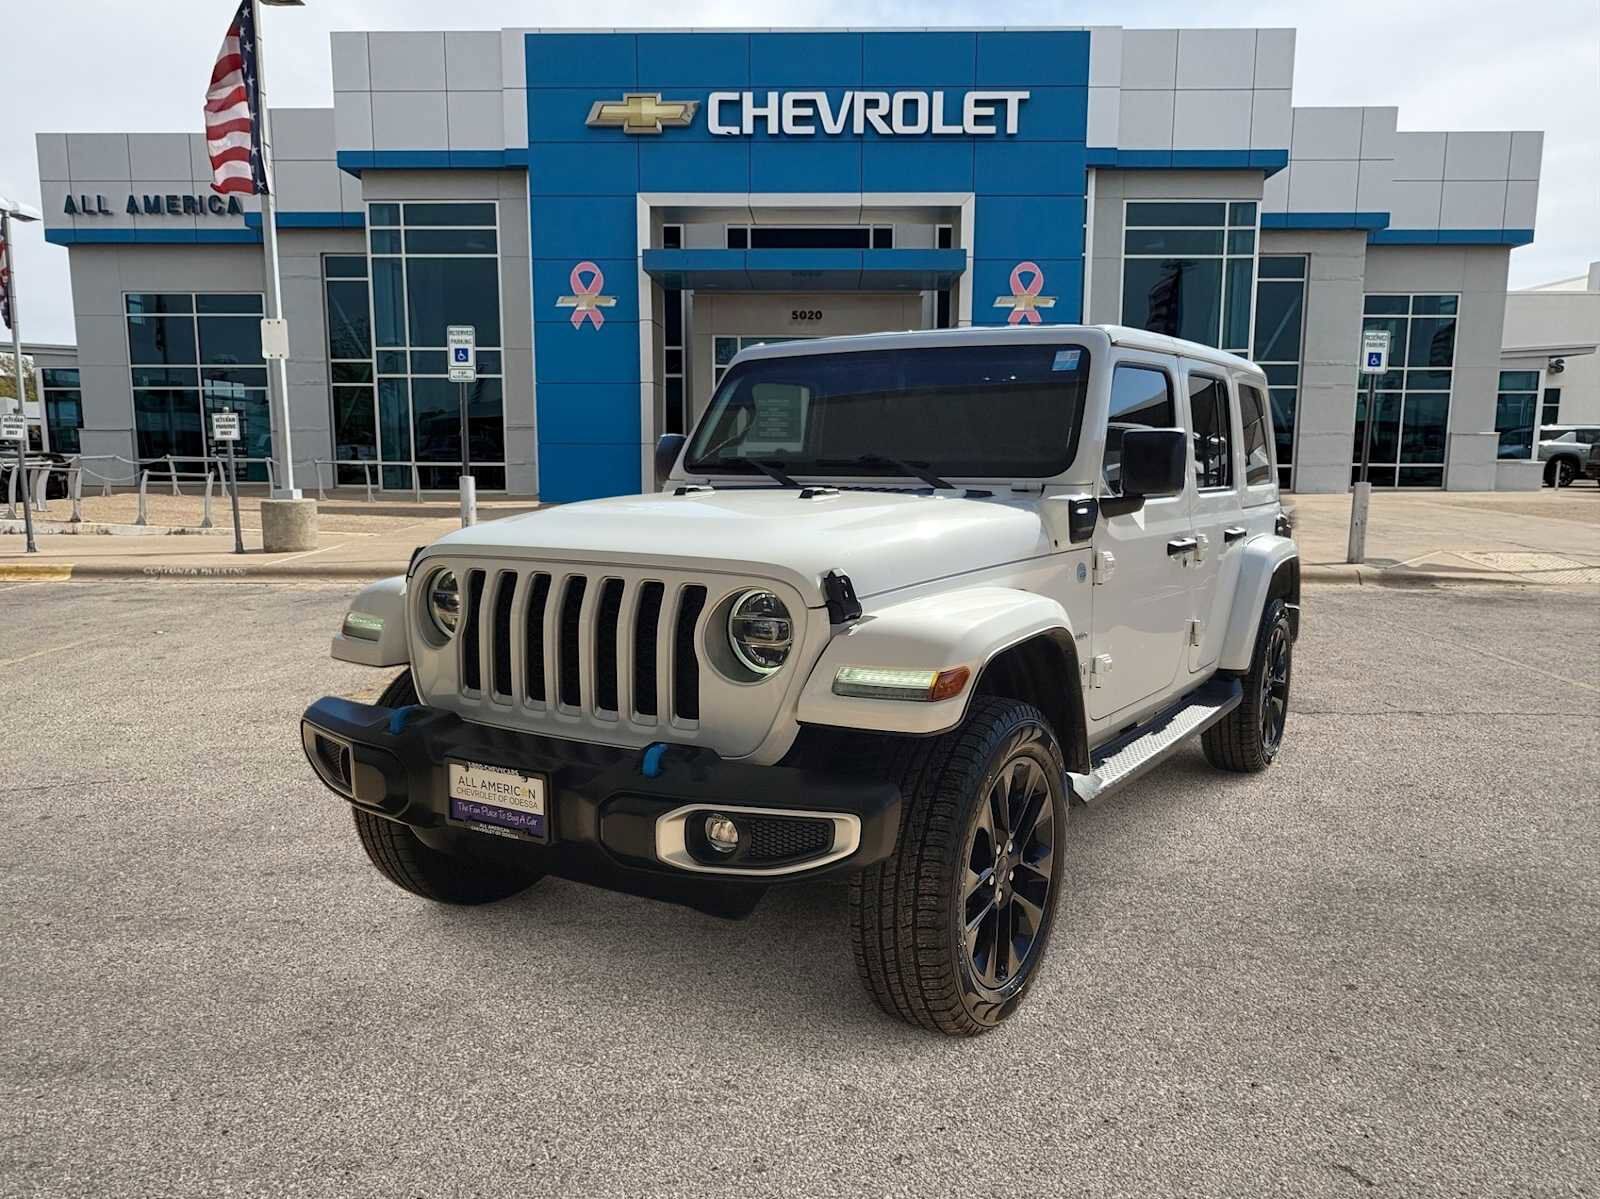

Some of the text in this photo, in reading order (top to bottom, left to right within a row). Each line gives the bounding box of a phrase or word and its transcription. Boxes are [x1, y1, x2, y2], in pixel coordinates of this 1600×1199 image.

[708, 91, 1030, 135] CHEVROLET
[64, 195, 243, 215] ALL AMERICA
[791, 310, 823, 320] 5020
[458, 776, 477, 788] ALL
[456, 787, 538, 809] CHEVROLET OF ODESSA
[480, 806, 498, 818] Place
[506, 812, 519, 826] Buy
